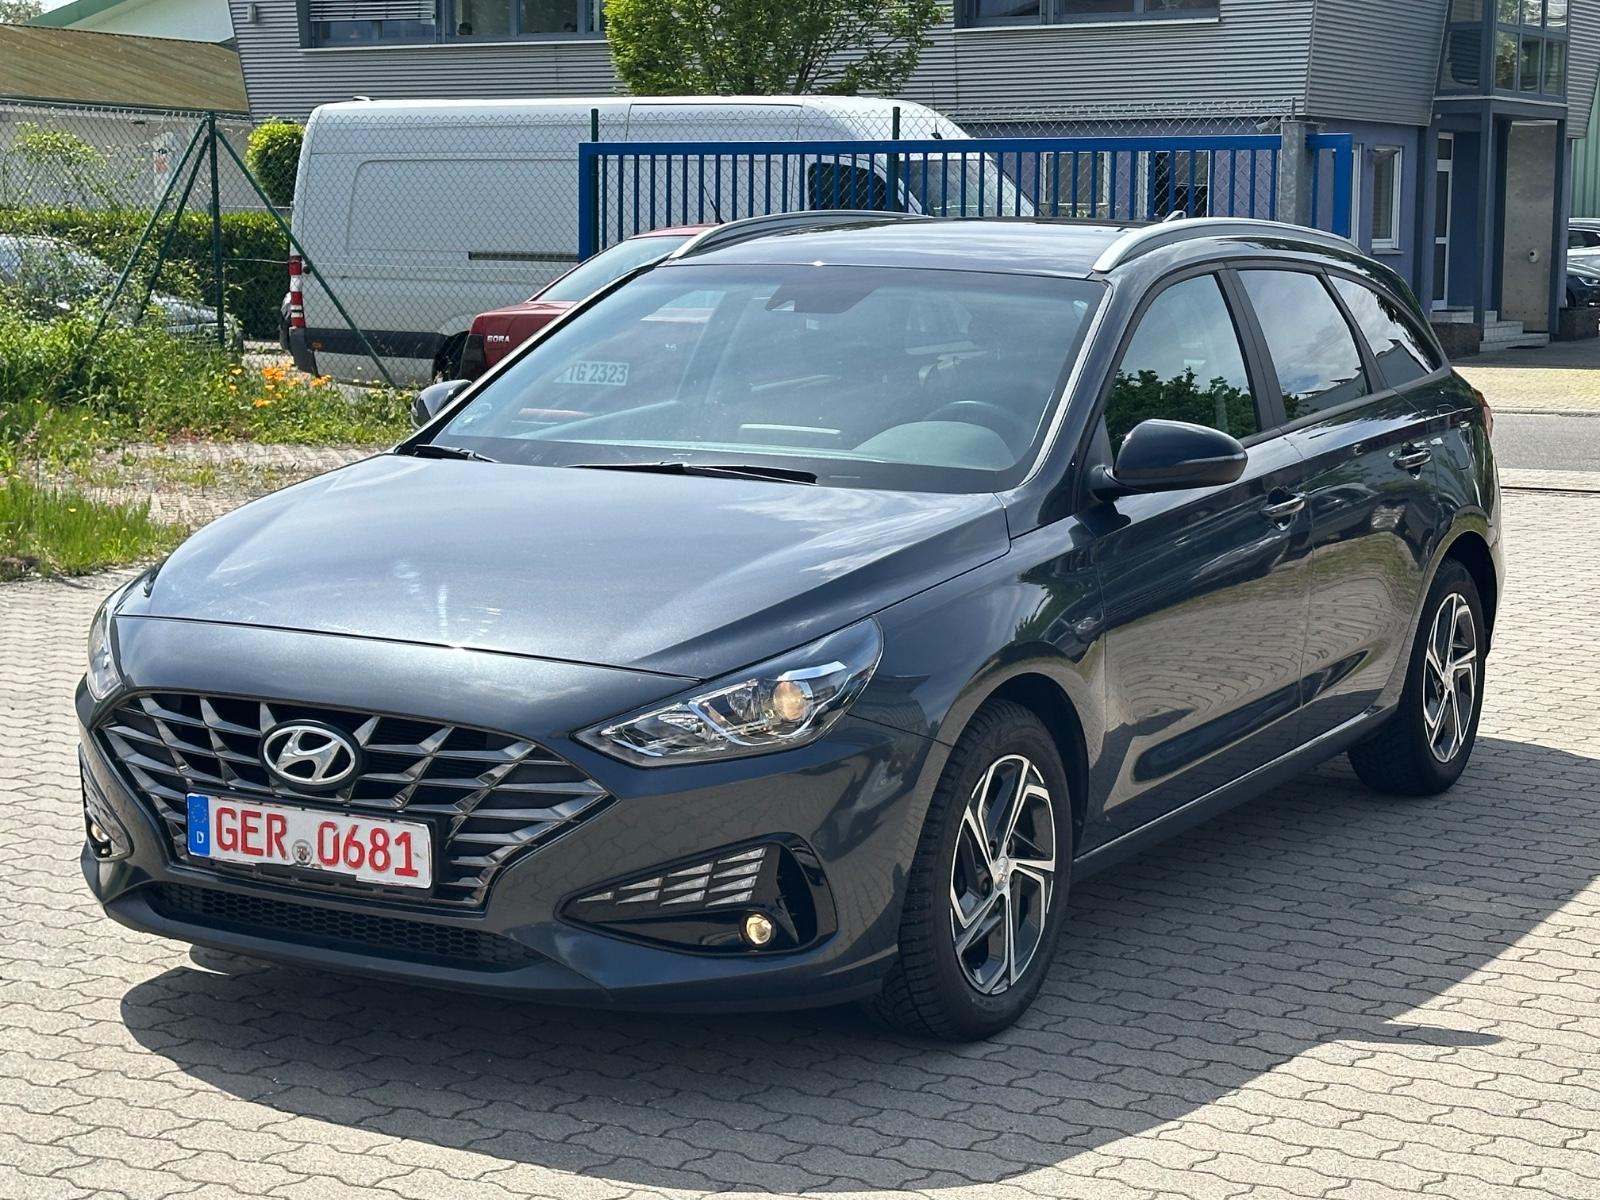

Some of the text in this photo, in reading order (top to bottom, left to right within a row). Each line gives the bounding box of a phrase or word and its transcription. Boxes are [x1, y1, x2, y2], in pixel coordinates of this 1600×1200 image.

[588, 363, 627, 383] 2323
[196, 831, 204, 844] D
[216, 807, 418, 877] GER 0681
